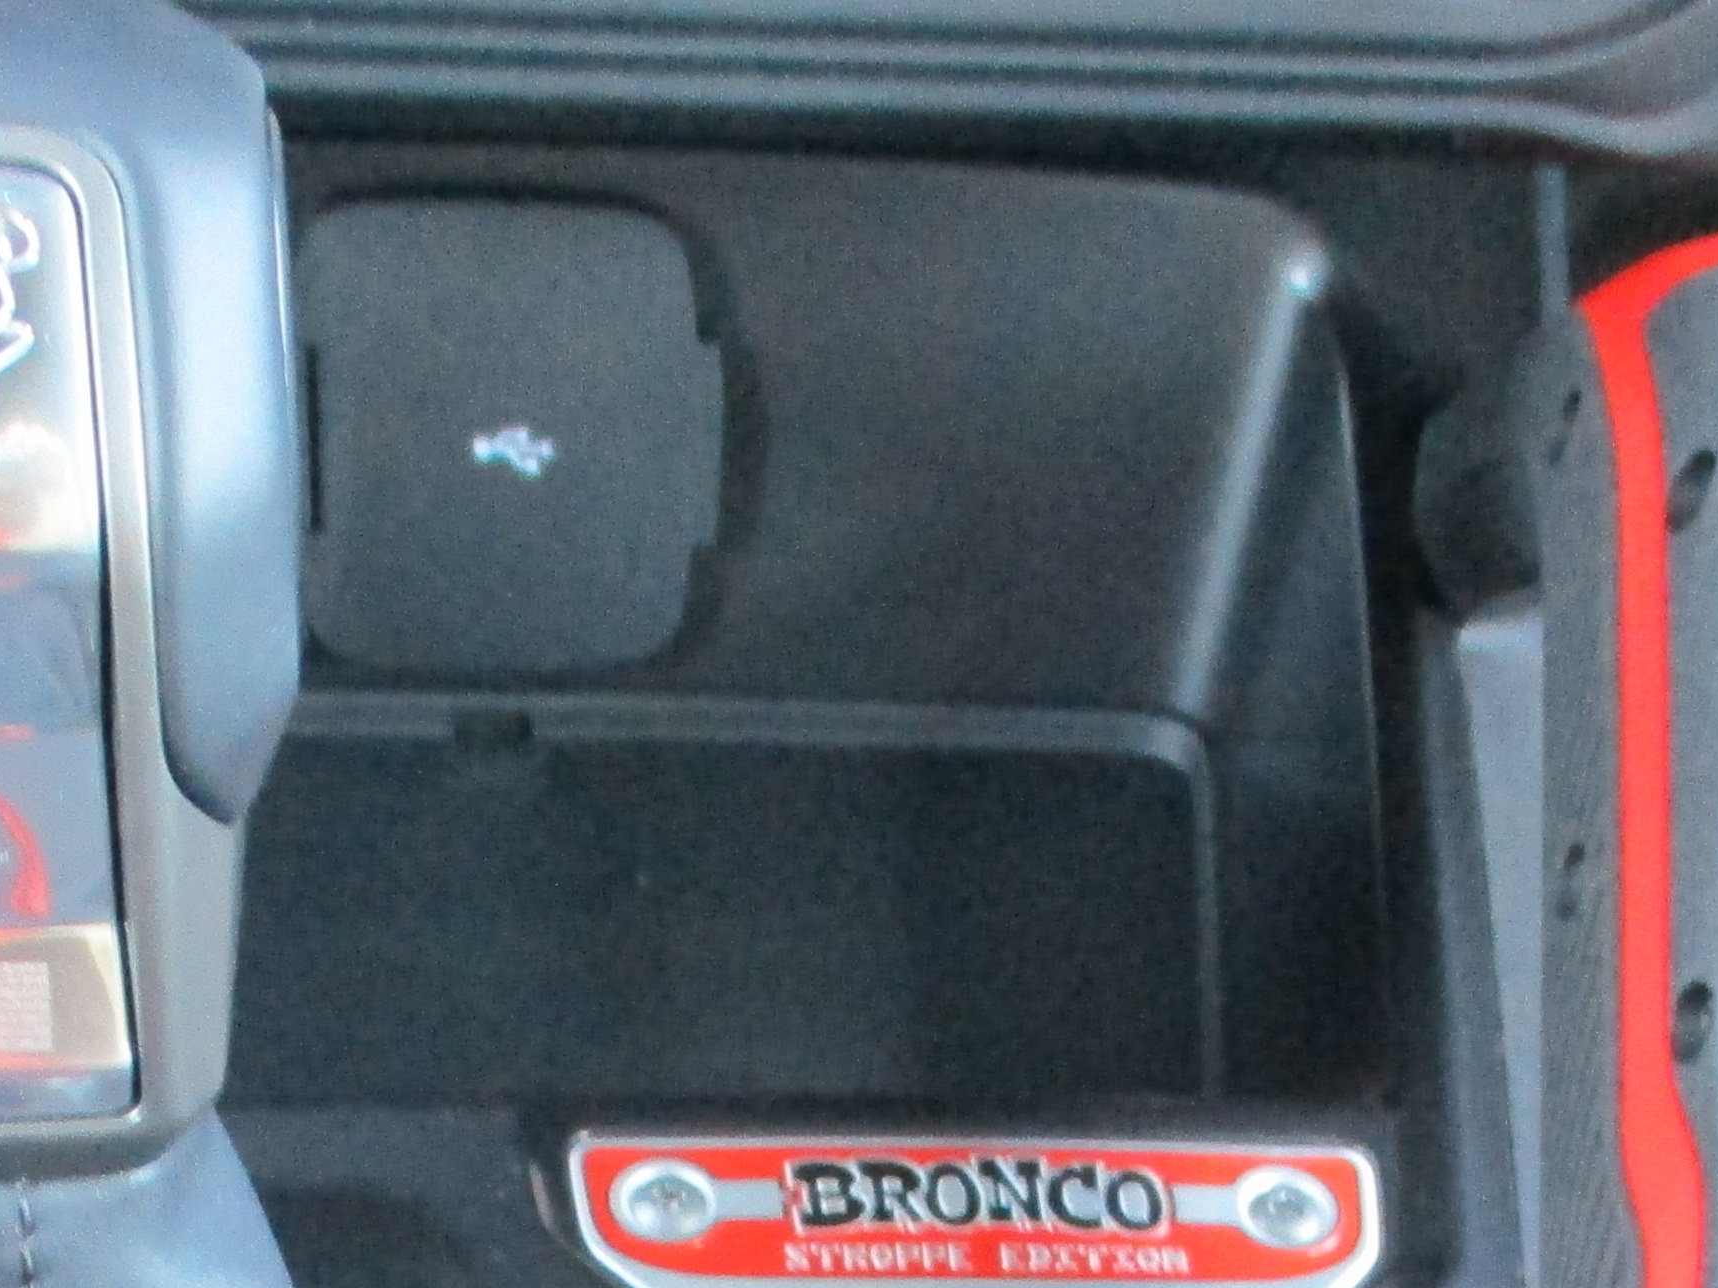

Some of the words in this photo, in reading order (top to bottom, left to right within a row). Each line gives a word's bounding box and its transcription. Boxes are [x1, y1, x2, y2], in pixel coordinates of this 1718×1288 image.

[789, 1157, 1167, 1232] BRONCO
[783, 1242, 974, 1274] STROPPE
[998, 1242, 1190, 1275] EDITION
